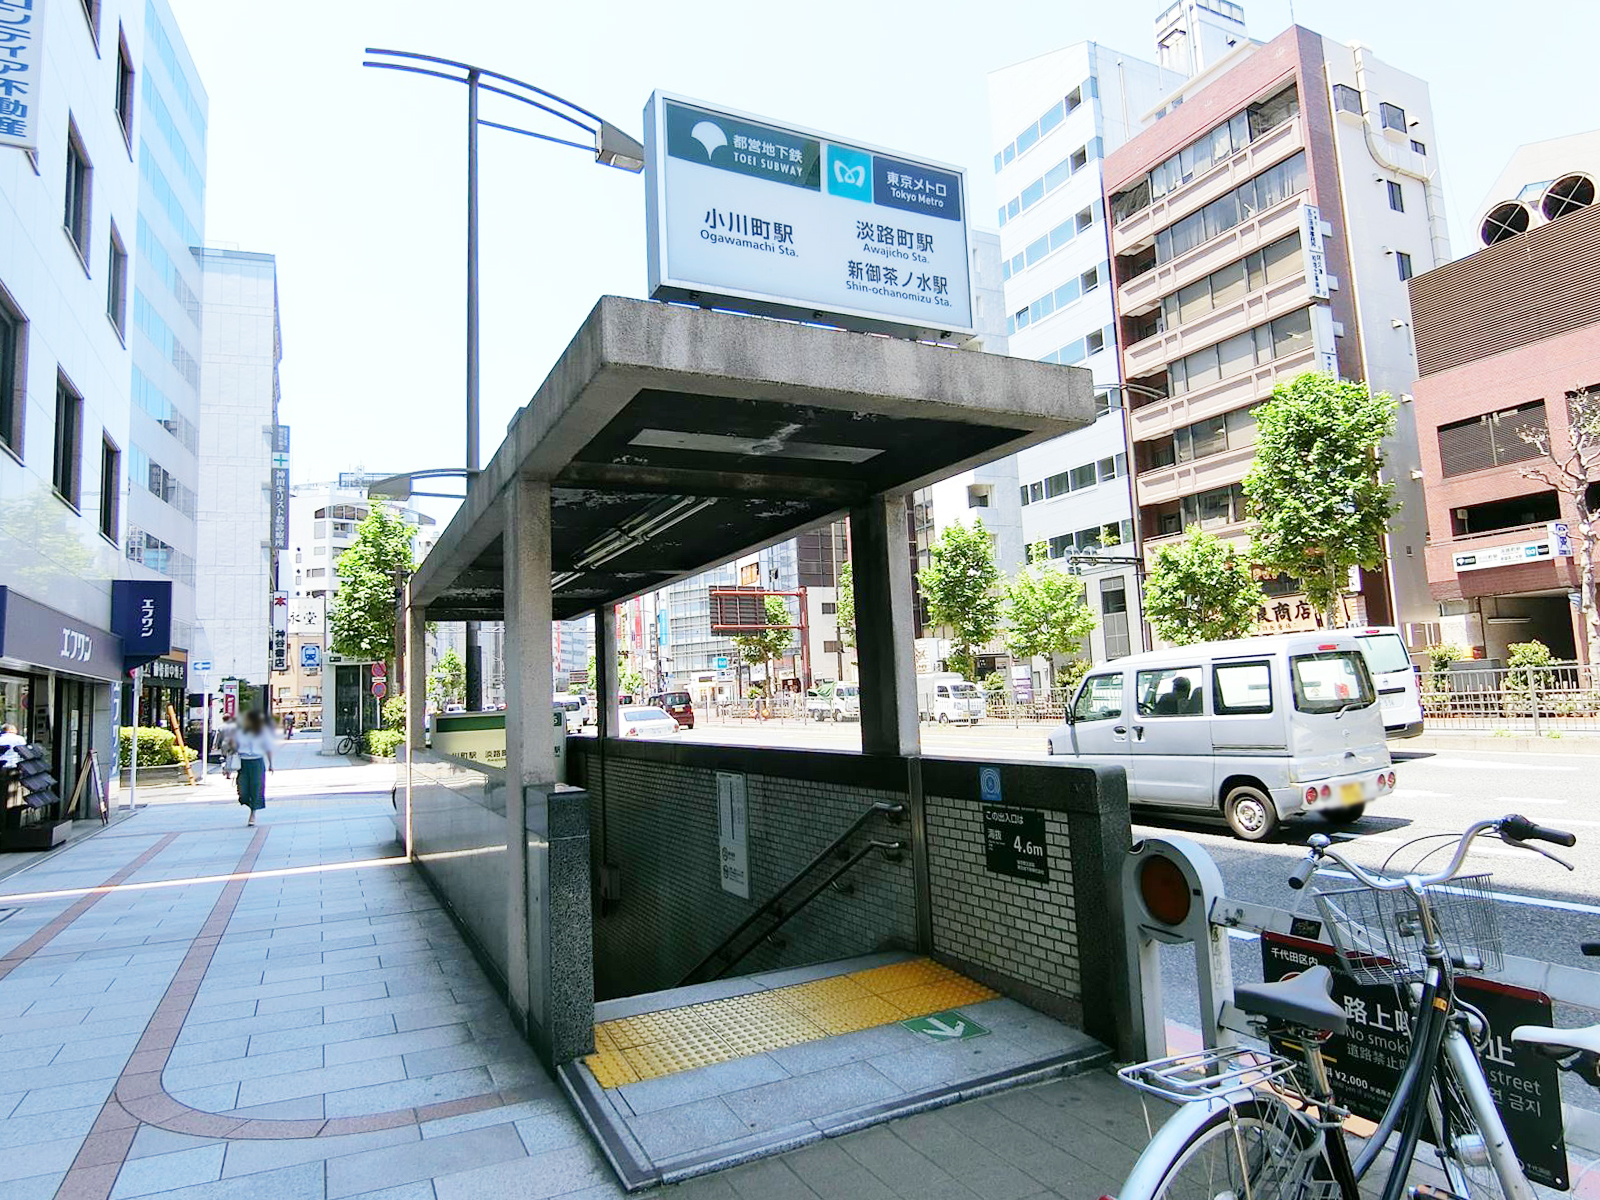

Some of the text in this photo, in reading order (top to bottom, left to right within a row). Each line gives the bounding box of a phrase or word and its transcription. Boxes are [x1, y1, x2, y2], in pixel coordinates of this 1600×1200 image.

[733, 135, 803, 164] 都営地下鉄
[733, 151, 803, 177] TOEI SUBWAY
[887, 171, 947, 197] 東京メトロ
[890, 187, 944, 208] Tokyo Metro
[704, 208, 794, 244] 小川町駅
[856, 220, 934, 254] 淡路町駅
[700, 229, 799, 258] Ogawamachi Sta.
[863, 243, 930, 264] Awajicho Sta.
[848, 260, 948, 295] 新御茶ノ水駅
[846, 280, 952, 308] Shin-ochanomizu Sta.
[141, 599, 153, 637] エフワン
[60, 627, 93, 662] エフワン
[1013, 835, 1043, 857] 4.6m
[1271, 947, 1319, 967] 千代田区内
[1346, 1024, 1364, 1041] No
[1489, 1070, 1542, 1097] street
[1335, 1070, 1368, 1090] ¥2,000
[1509, 1093, 1541, 1118] 금지
